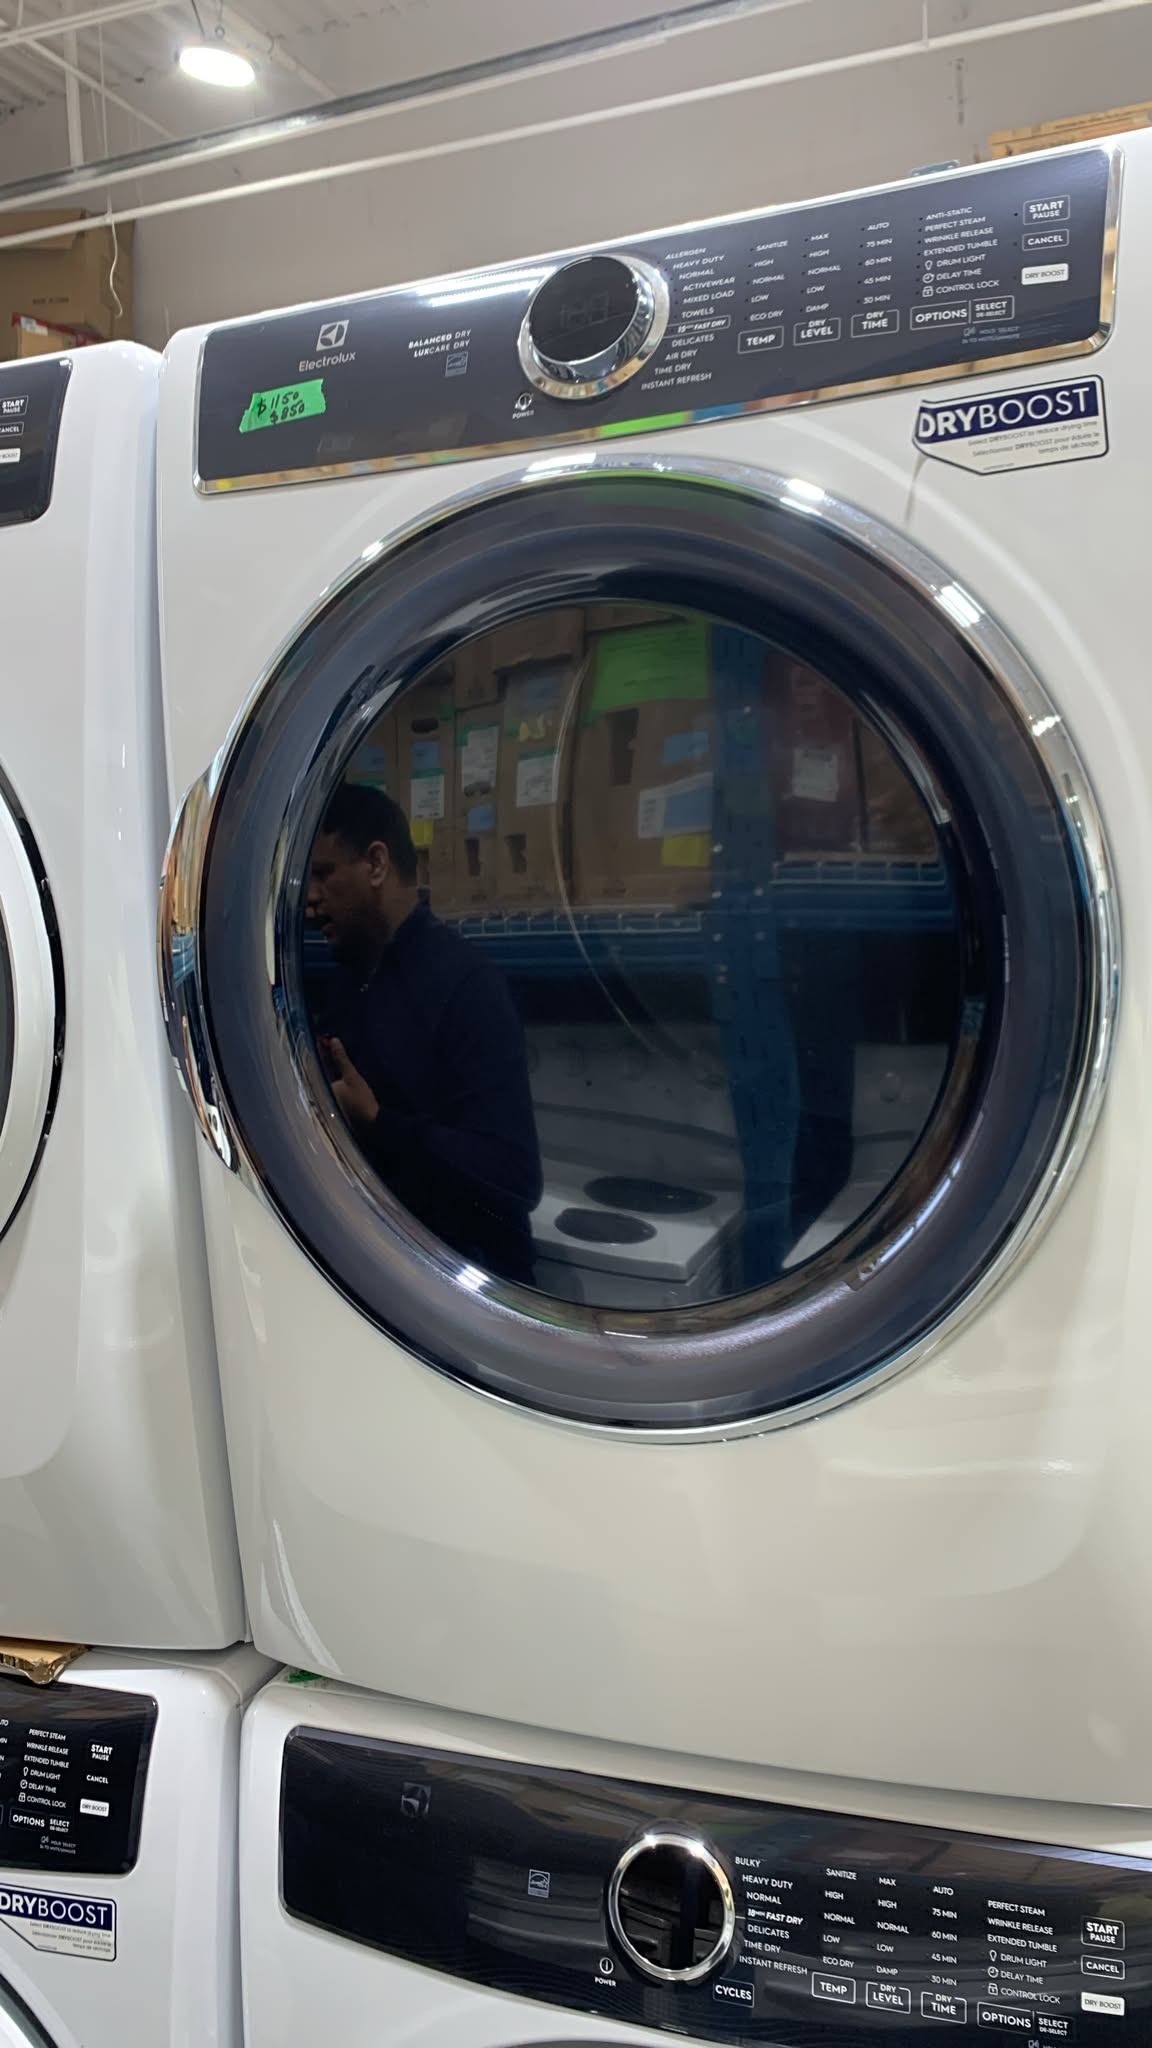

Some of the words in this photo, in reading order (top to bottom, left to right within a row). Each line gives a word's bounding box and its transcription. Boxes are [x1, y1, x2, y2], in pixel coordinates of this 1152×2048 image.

[1029, 200, 1064, 213] START
[926, 207, 972, 221] ANTI-STATIC
[1032, 211, 1060, 219] PAUSE
[868, 222, 889, 231] AUTO
[925, 221, 957, 232] PERFECT
[960, 217, 986, 226] STEAM
[811, 233, 829, 241] MAX
[924, 232, 959, 244] WRINKLE
[961, 227, 994, 238] RELEASE
[1028, 235, 1063, 245] CANCEL
[756, 241, 788, 252] SANITIZE
[877, 238, 892, 246] MIN
[924, 244, 965, 256] EXTENDED
[967, 239, 998, 250] TUMBLE
[665, 247, 706, 260] ALLERGEN
[809, 250, 830, 258] HIGH
[673, 260, 701, 270] HEAVY
[702, 255, 724, 265] DUTY
[754, 259, 774, 268] HIGH
[876, 256, 892, 264] MIN
[937, 257, 961, 267] DRUM
[963, 254, 986, 263] LIGHT
[679, 269, 715, 280] NORMAL
[808, 265, 841, 275] NORMAL
[937, 271, 963, 281] DELAY
[964, 269, 982, 277] TIME
[1041, 269, 1065, 277] BOOST
[682, 277, 735, 292] ACTIVEWEAR
[753, 275, 785, 285] NORMAL
[875, 275, 891, 283] MIN
[807, 285, 825, 294] LOW
[936, 282, 974, 294] CONTROL
[976, 280, 999, 289] LOCK
[683, 293, 710, 304] MIXED
[711, 290, 735, 300] LOAD
[751, 294, 769, 303] LOW
[875, 294, 890, 303] MIN
[806, 303, 829, 312] DAMP
[975, 302, 1007, 311] SELECT
[681, 307, 714, 318] TOWELS
[750, 313, 767, 321] ECO
[768, 310, 784, 320] DRY
[866, 311, 884, 319] DRY
[915, 309, 968, 323] OPTIONS
[711, 319, 726, 328] DRY
[809, 319, 825, 327] DRY
[862, 319, 888, 330] TIME
[801, 326, 833, 338] LEVEL
[408, 333, 452, 349] BALANCED
[454, 328, 471, 340] DRY
[672, 333, 714, 348] DELICATES
[747, 335, 775, 346] TEMP
[414, 343, 450, 358] LUXCARE
[454, 338, 470, 350] DRY
[665, 351, 679, 361] AIR
[681, 349, 697, 359] DRY
[299, 351, 355, 372] Electrolux
[655, 366, 673, 375] TIME
[675, 363, 691, 372] DRY
[641, 379, 675, 390] INSTANT
[677, 372, 712, 384] REFRESH
[2, 399, 24, 408] START
[512, 410, 534, 419] POWER
[918, 387, 1090, 438] DRYBOOST
[29, 1729, 49, 1737] PERFECT
[27, 1742, 47, 1751] WRINKLE
[48, 1746, 68, 1755] RELEASE
[91, 1744, 112, 1755] START
[24, 1755, 49, 1765] EXTENDED
[50, 1759, 69, 1768] TUMBLE
[92, 1753, 109, 1761] PAUSE
[30, 1769, 45, 1777] DRUM
[46, 1772, 60, 1780] LIGHT
[87, 1775, 108, 1784] CANCEL
[29, 1782, 44, 1791] DELAY
[27, 1796, 51, 1806] CONTROL
[52, 1800, 66, 1808] LOCK
[92, 1804, 107, 1812] BOOST
[13, 1815, 45, 1828] OPTIONS
[50, 1818, 69, 1828] SELECT
[735, 1857, 761, 1868] BULKY
[826, 1868, 857, 1880] SANITIZE
[743, 1875, 769, 1886] HEAVY
[771, 1879, 793, 1889] DUTY
[879, 1877, 896, 1886] MAX
[825, 1891, 843, 1900] HIGH
[933, 1886, 954, 1896] AUTO
[747, 1892, 781, 1904] NORMAL
[0, 1892, 108, 1926] DRYBOOST
[878, 1899, 897, 1909] HIGH
[988, 1900, 1019, 1912] PERFECT
[1020, 1906, 1045, 1916] STEAM
[766, 1911, 786, 1921] FAST
[786, 1915, 803, 1925] DRY
[824, 1913, 855, 1924] NORMAL
[932, 1908, 941, 1916] 75
[942, 1910, 957, 1919] MIN
[748, 1924, 790, 1939] DELICATES
[877, 1921, 909, 1934] NORMAL
[988, 1918, 1020, 1930] WRINKLE
[1022, 1922, 1053, 1935] RELEASE
[1086, 1922, 1119, 1936] START
[824, 1934, 840, 1943] LOW
[932, 1931, 941, 1939] 60
[942, 1933, 957, 1942] MIN
[1090, 1933, 1115, 1944] PAUSE
[744, 1940, 763, 1950] TIME
[764, 1943, 781, 1953] DRY
[877, 1943, 893, 1952] LOW
[988, 1935, 1026, 1948] EXTENDED
[1028, 1941, 1057, 1952] TUMBLE
[823, 1956, 838, 1965] ECO
[839, 1959, 854, 1968] DRY
[932, 1954, 941, 1962] 45
[942, 1955, 957, 1964] MIN
[1001, 1954, 1024, 1964] DRUM
[1025, 1958, 1047, 1968] LIGHT
[740, 1956, 773, 1968] INSTANT
[774, 1961, 808, 1974] REFRESH
[1086, 1962, 1119, 1974] CANCEL
[877, 1966, 898, 1976] DAMP
[595, 1976, 616, 1987] POWER
[942, 1977, 957, 1986] MIN
[1001, 1970, 1025, 1981] DELAY
[1027, 1975, 1043, 1984] TIME
[716, 1985, 752, 2000] CYCLES
[820, 1981, 847, 1995] TEMP
[880, 1984, 897, 1993] DRY
[873, 1991, 904, 2005] LEVEL
[936, 1994, 952, 2003] DRY
[1001, 1987, 1037, 2001] CONTROL
[1038, 1993, 1061, 2004] LOCK
[932, 2003, 957, 2015] TIME
[1084, 1998, 1097, 2006] DRY
[1099, 2001, 1122, 2010] BOOST
[982, 2011, 1031, 2028] OPTIONS
[1039, 2018, 1068, 2029] SELECT
[1040, 2027, 1067, 2036] DE-SELECT
